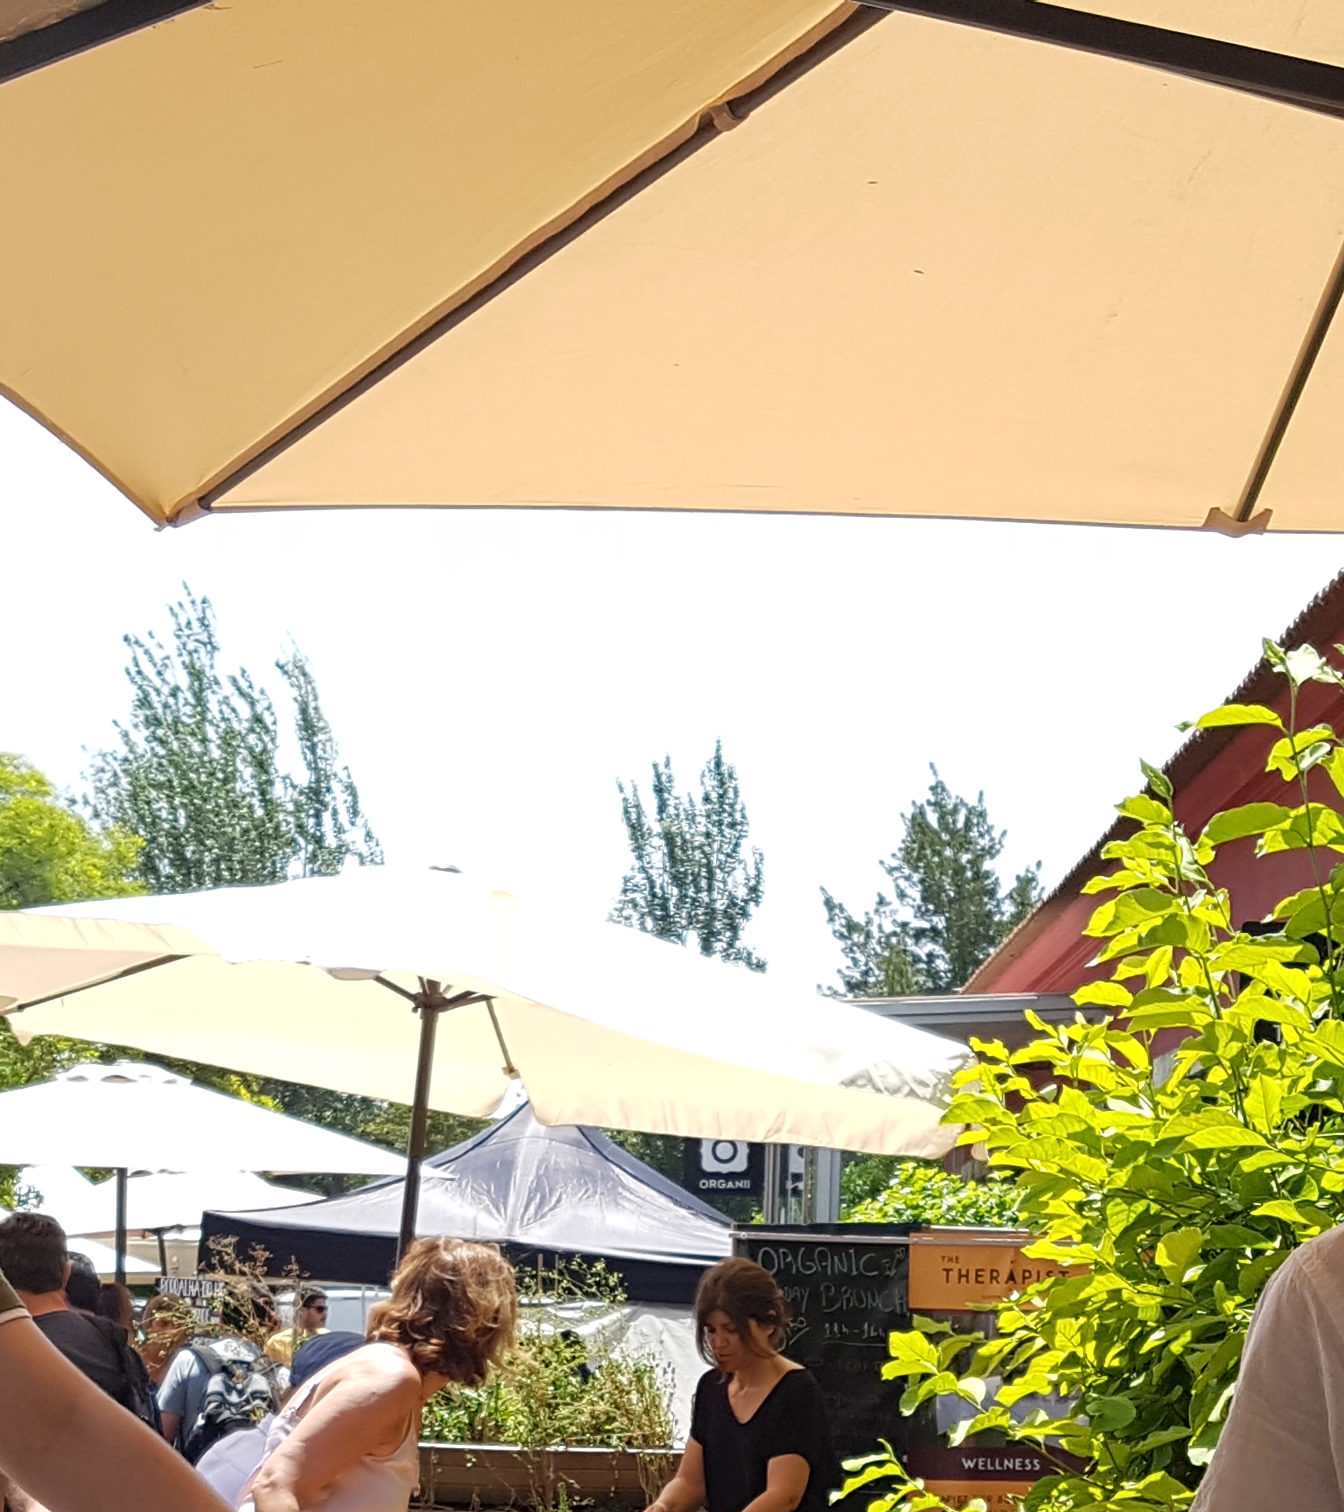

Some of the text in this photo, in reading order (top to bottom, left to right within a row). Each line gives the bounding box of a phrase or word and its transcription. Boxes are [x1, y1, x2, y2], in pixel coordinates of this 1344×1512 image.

[758, 1247, 879, 1276] ORGANIC
[941, 1255, 960, 1264] THE
[820, 1281, 907, 1314] BRUNCH
[962, 1457, 1041, 1471] WELLNESS
